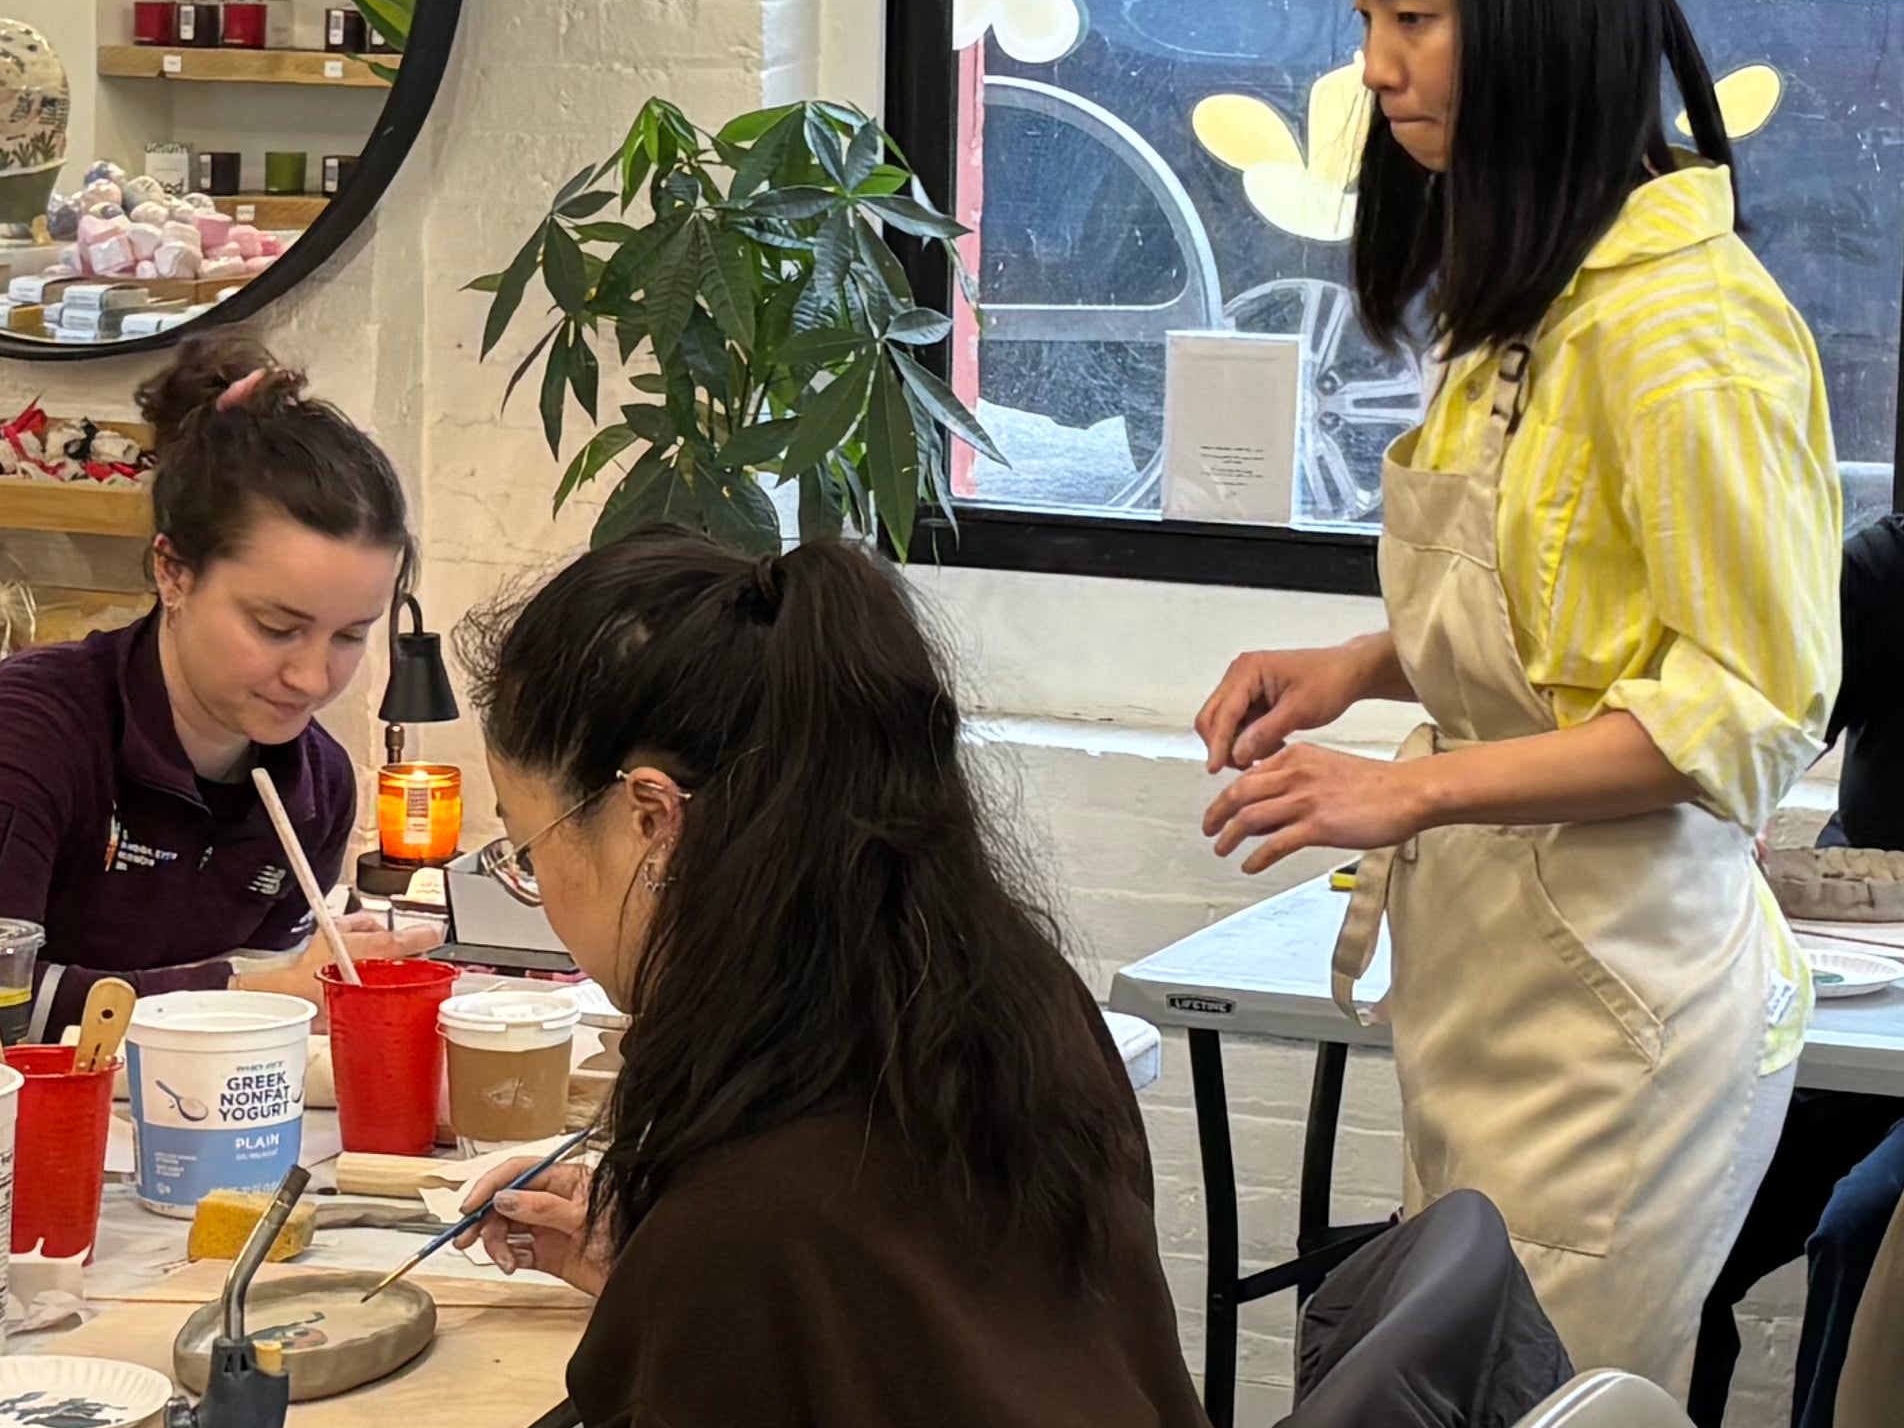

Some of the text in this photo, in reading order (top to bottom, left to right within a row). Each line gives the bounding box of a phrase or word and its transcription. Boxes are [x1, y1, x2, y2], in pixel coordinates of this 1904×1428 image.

[226, 1071, 287, 1091] GREEK
[220, 1084, 290, 1107] NONFAT
[219, 1100, 289, 1122] YOGURT
[235, 1131, 280, 1150] PLAIN
